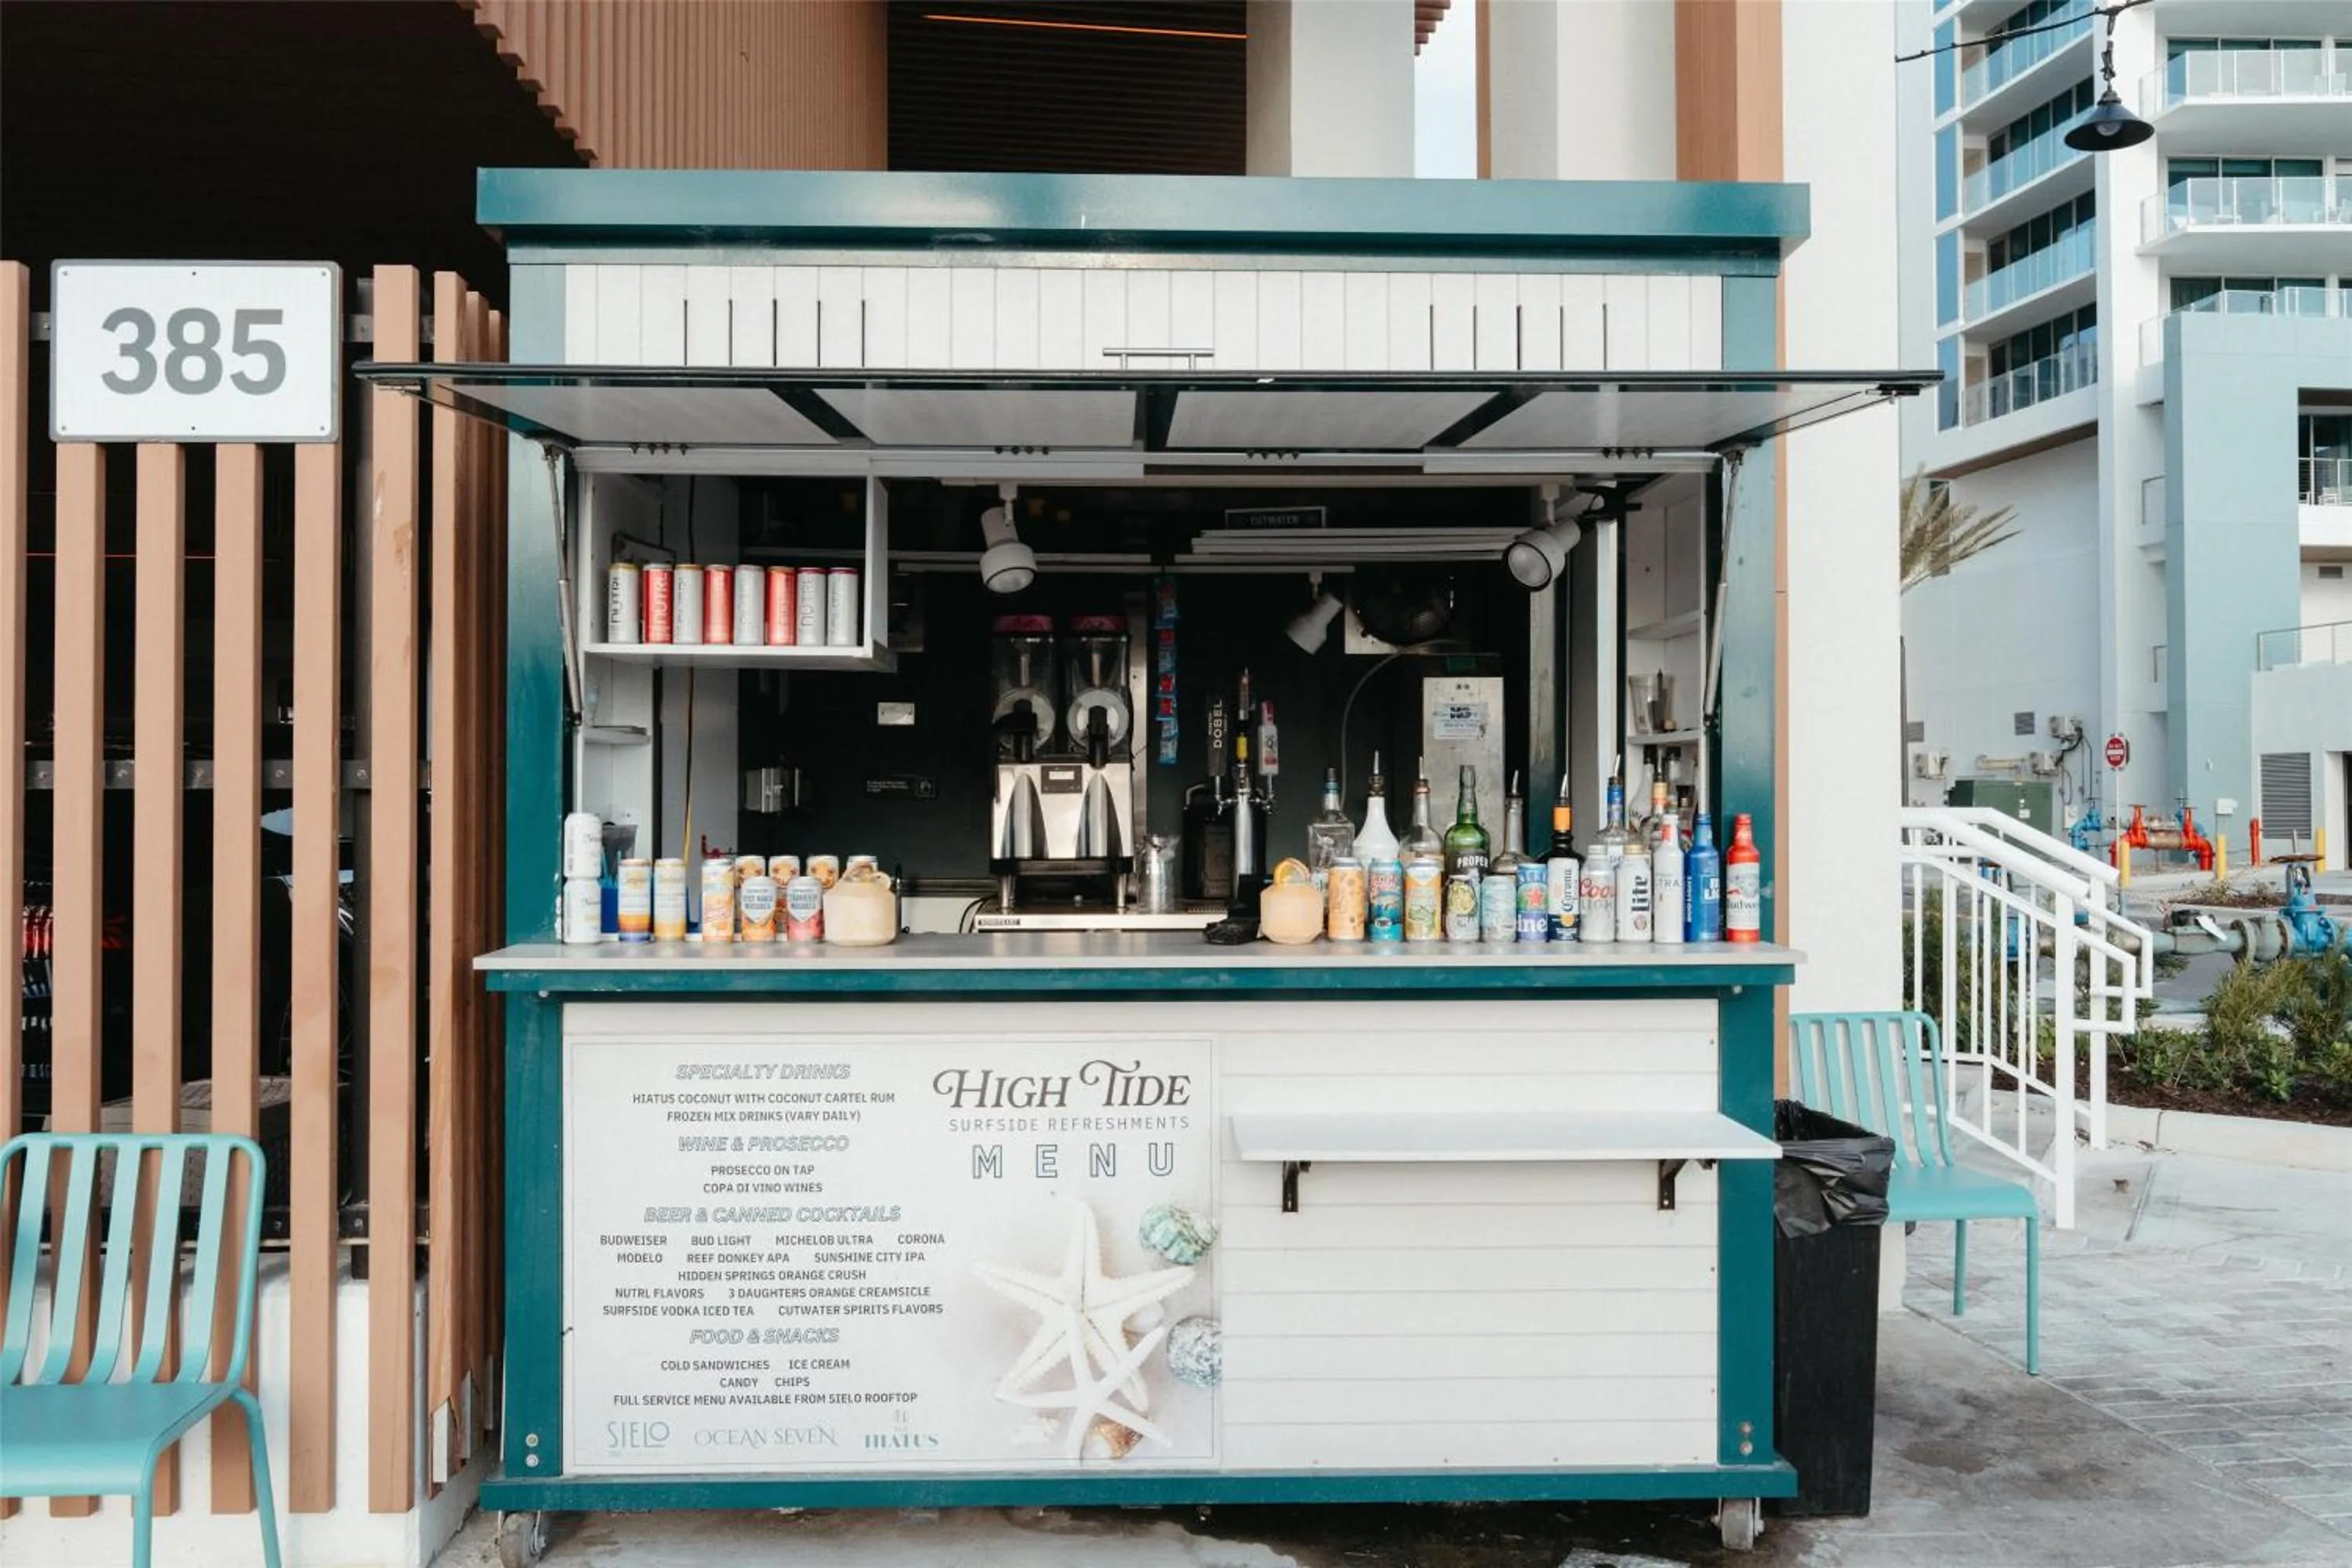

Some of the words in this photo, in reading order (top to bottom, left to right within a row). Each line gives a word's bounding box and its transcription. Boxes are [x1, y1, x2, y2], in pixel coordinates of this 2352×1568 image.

[101, 307, 287, 395] 385
[1213, 699, 1222, 748] DOBEL
[1581, 878, 1615, 898] Coo
[1656, 878, 1682, 889] TRA
[1581, 900, 1613, 910] LIGH
[675, 1063, 779, 1080] SPECIALTY
[779, 1063, 851, 1080] DRINKS
[933, 1069, 1072, 1109] HIGH
[1080, 1059, 1192, 1107] TIDE
[633, 1093, 675, 1105] HIATUS
[677, 1093, 731, 1105] COCONUT
[734, 1093, 766, 1104] WITH
[768, 1092, 822, 1104] COCONUT
[824, 1092, 868, 1104] CARTEL
[869, 1092, 895, 1103] RUM
[666, 1111, 712, 1123] FROZEN
[714, 1111, 736, 1122] MIX
[739, 1111, 783, 1122] DRINKS
[785, 1110, 820, 1123] (VARY
[822, 1110, 861, 1122] DAILY)
[947, 1117, 1040, 1132] SURFSIDE
[1047, 1115, 1190, 1131] REFRESHMENTS
[678, 1135, 729, 1152] WINE
[730, 1135, 745, 1152] &
[747, 1134, 850, 1152] PROSECCO
[971, 1142, 1174, 1179] MENU
[710, 1164, 771, 1176] PROSECCO
[773, 1164, 790, 1176] ON
[793, 1164, 815, 1175] TAP
[702, 1182, 735, 1194] COPA
[736, 1182, 750, 1193] DI
[752, 1182, 782, 1193] VINO
[783, 1181, 823, 1192] WINES
[643, 1206, 692, 1224] BEER
[694, 1207, 709, 1224] &
[712, 1207, 793, 1224] CANNED
[795, 1205, 902, 1223] COCKTAILS
[600, 1234, 668, 1247] BUDWEISER
[691, 1235, 715, 1247] BUD
[717, 1235, 752, 1247] LIGHT
[775, 1235, 835, 1246] MICHELOB
[837, 1234, 874, 1246] ULTRA
[897, 1233, 946, 1245] CORONA
[616, 1252, 663, 1264] MODELO
[686, 1253, 714, 1264] REEF
[717, 1252, 764, 1263] DONKEY
[766, 1252, 790, 1263] APA
[815, 1251, 873, 1263] SUNSHINE
[875, 1251, 902, 1263] CITY
[905, 1251, 926, 1262] IPA
[677, 1271, 722, 1282] HIDDEN
[724, 1270, 775, 1281] SPRINGS
[778, 1269, 826, 1280] ORANGE
[827, 1269, 866, 1280] CRUSH
[615, 1287, 651, 1299] NUTRL
[653, 1287, 705, 1299] FLAVORS
[728, 1288, 735, 1299] 3
[737, 1287, 807, 1299] DAUGHTERS
[808, 1287, 856, 1298] ORANGE
[858, 1286, 931, 1298] CREAMSICLE
[602, 1305, 659, 1316] SURFSIDE
[660, 1305, 700, 1316] VODKA
[702, 1305, 731, 1316] ICED
[731, 1305, 755, 1316] TEA
[778, 1305, 840, 1316] CUTWATER
[843, 1304, 890, 1316] SPIRITS
[891, 1304, 944, 1315] FLAVORS
[689, 1329, 744, 1345] FOOD
[746, 1327, 761, 1345] &
[762, 1327, 840, 1345] SNACKS
[660, 1360, 691, 1371] COLD
[692, 1359, 771, 1371] SANDWICHES
[789, 1359, 808, 1370] ICE
[810, 1359, 851, 1370] CREAM
[719, 1377, 758, 1388] CANDY
[774, 1376, 811, 1388] CHIPS
[613, 1395, 640, 1406] FULL
[642, 1395, 691, 1406] SERVICE
[693, 1395, 727, 1406] MENU
[728, 1394, 792, 1405] AVAILABLE
[794, 1393, 826, 1404] FROM
[829, 1393, 862, 1404] SIELO
[864, 1392, 918, 1403] ROOFTOP
[607, 1421, 670, 1449] SIELO
[694, 1428, 768, 1449] OCEAN
[773, 1425, 840, 1449] SEVEN
